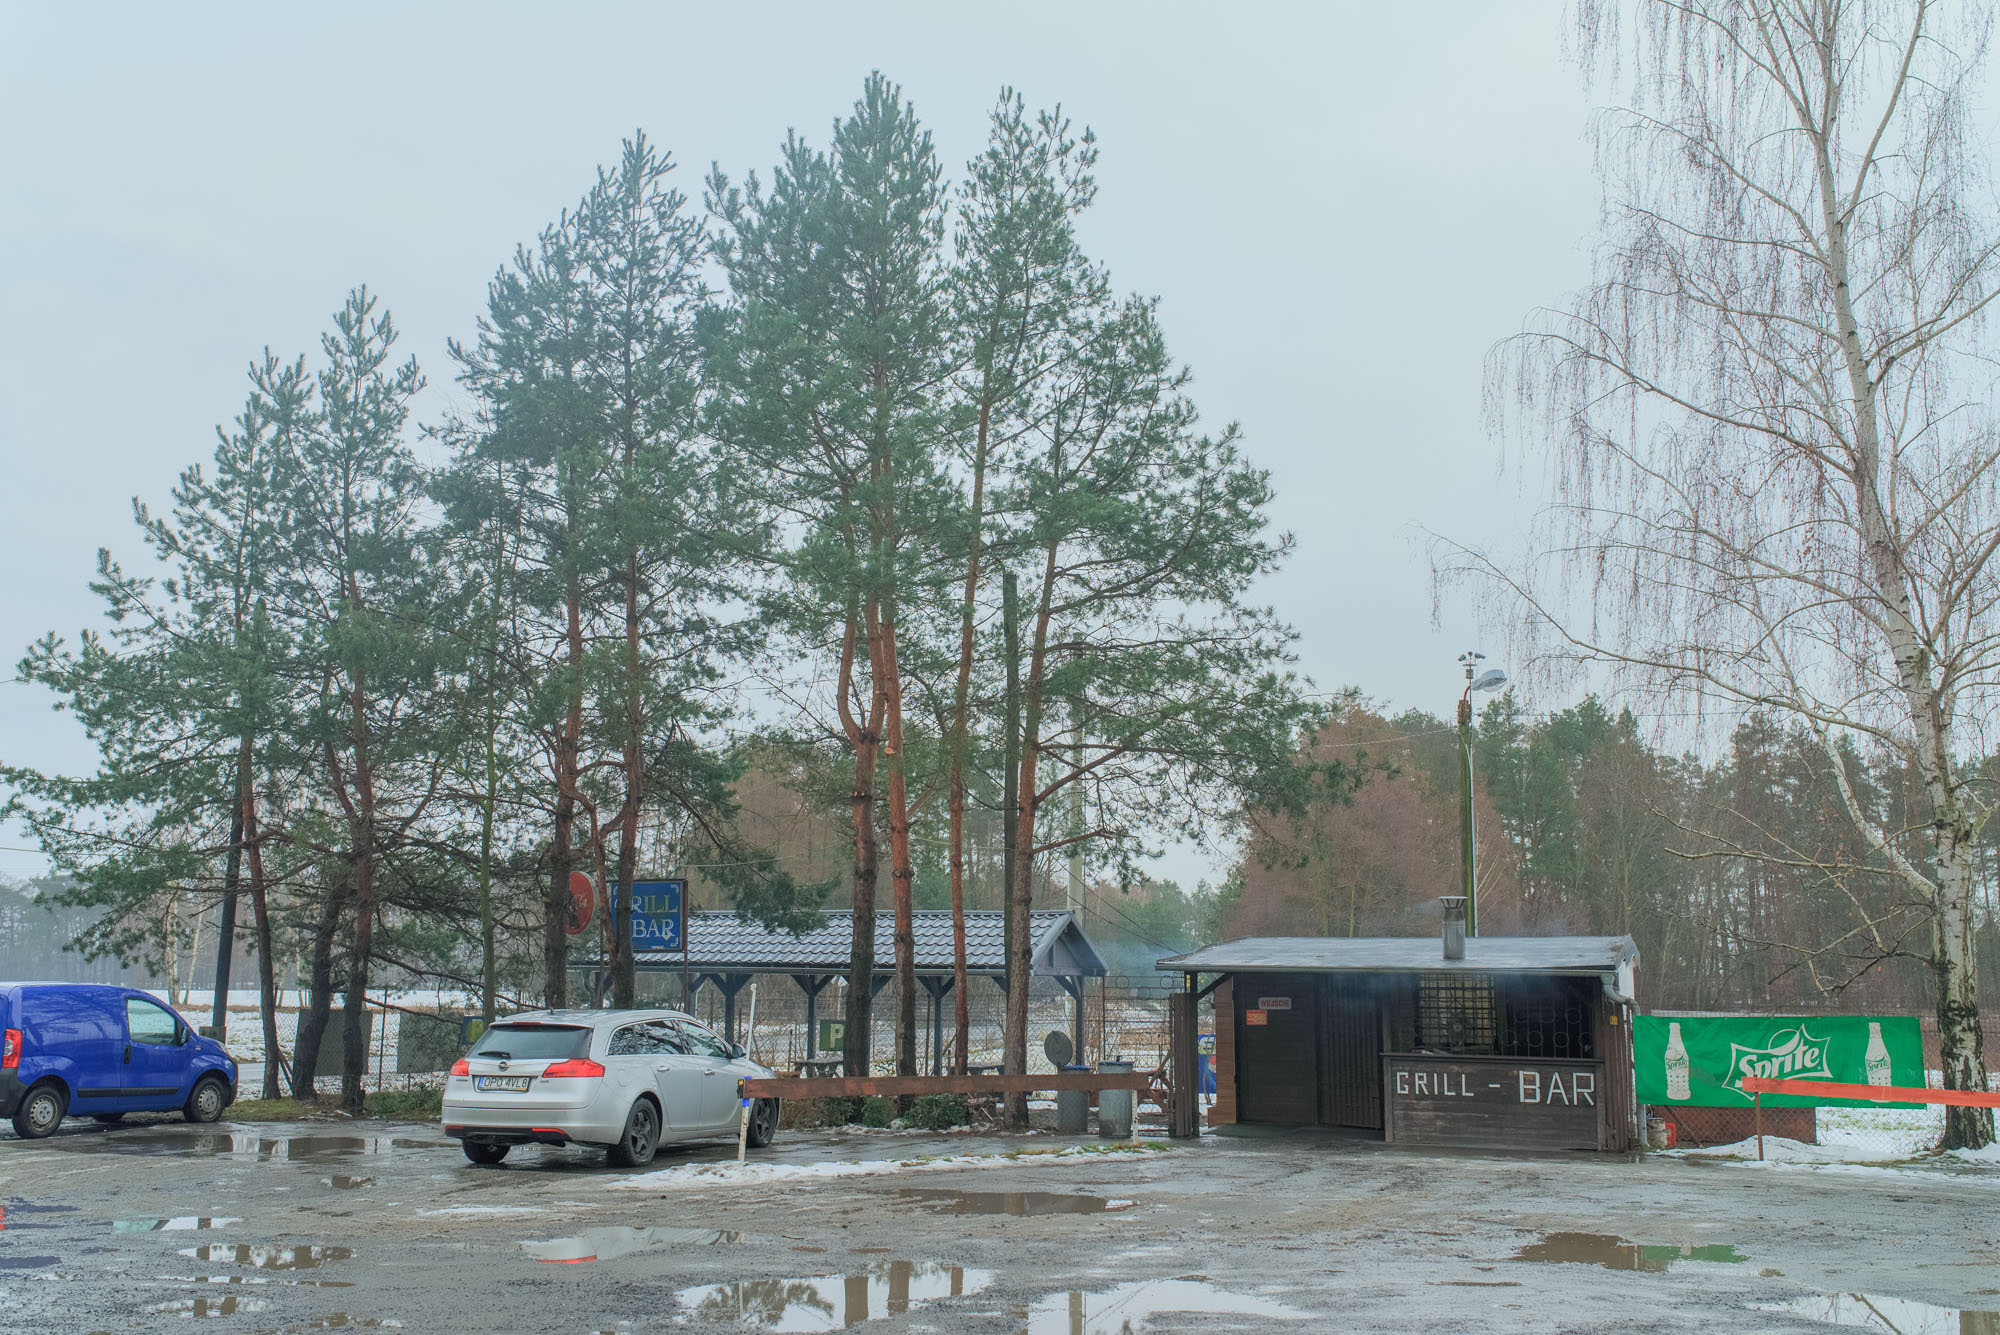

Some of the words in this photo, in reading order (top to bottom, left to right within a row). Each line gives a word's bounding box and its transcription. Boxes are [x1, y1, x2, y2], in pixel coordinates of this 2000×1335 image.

[614, 895, 678, 913] RILL
[632, 919, 676, 938] BAR
[830, 1024, 844, 1048] P
[1739, 1038, 1820, 1079] Sprite
[505, 1078, 527, 1088] 4VL8
[1396, 1071, 1474, 1097] GRILL
[1518, 1070, 1595, 1106] BAR
